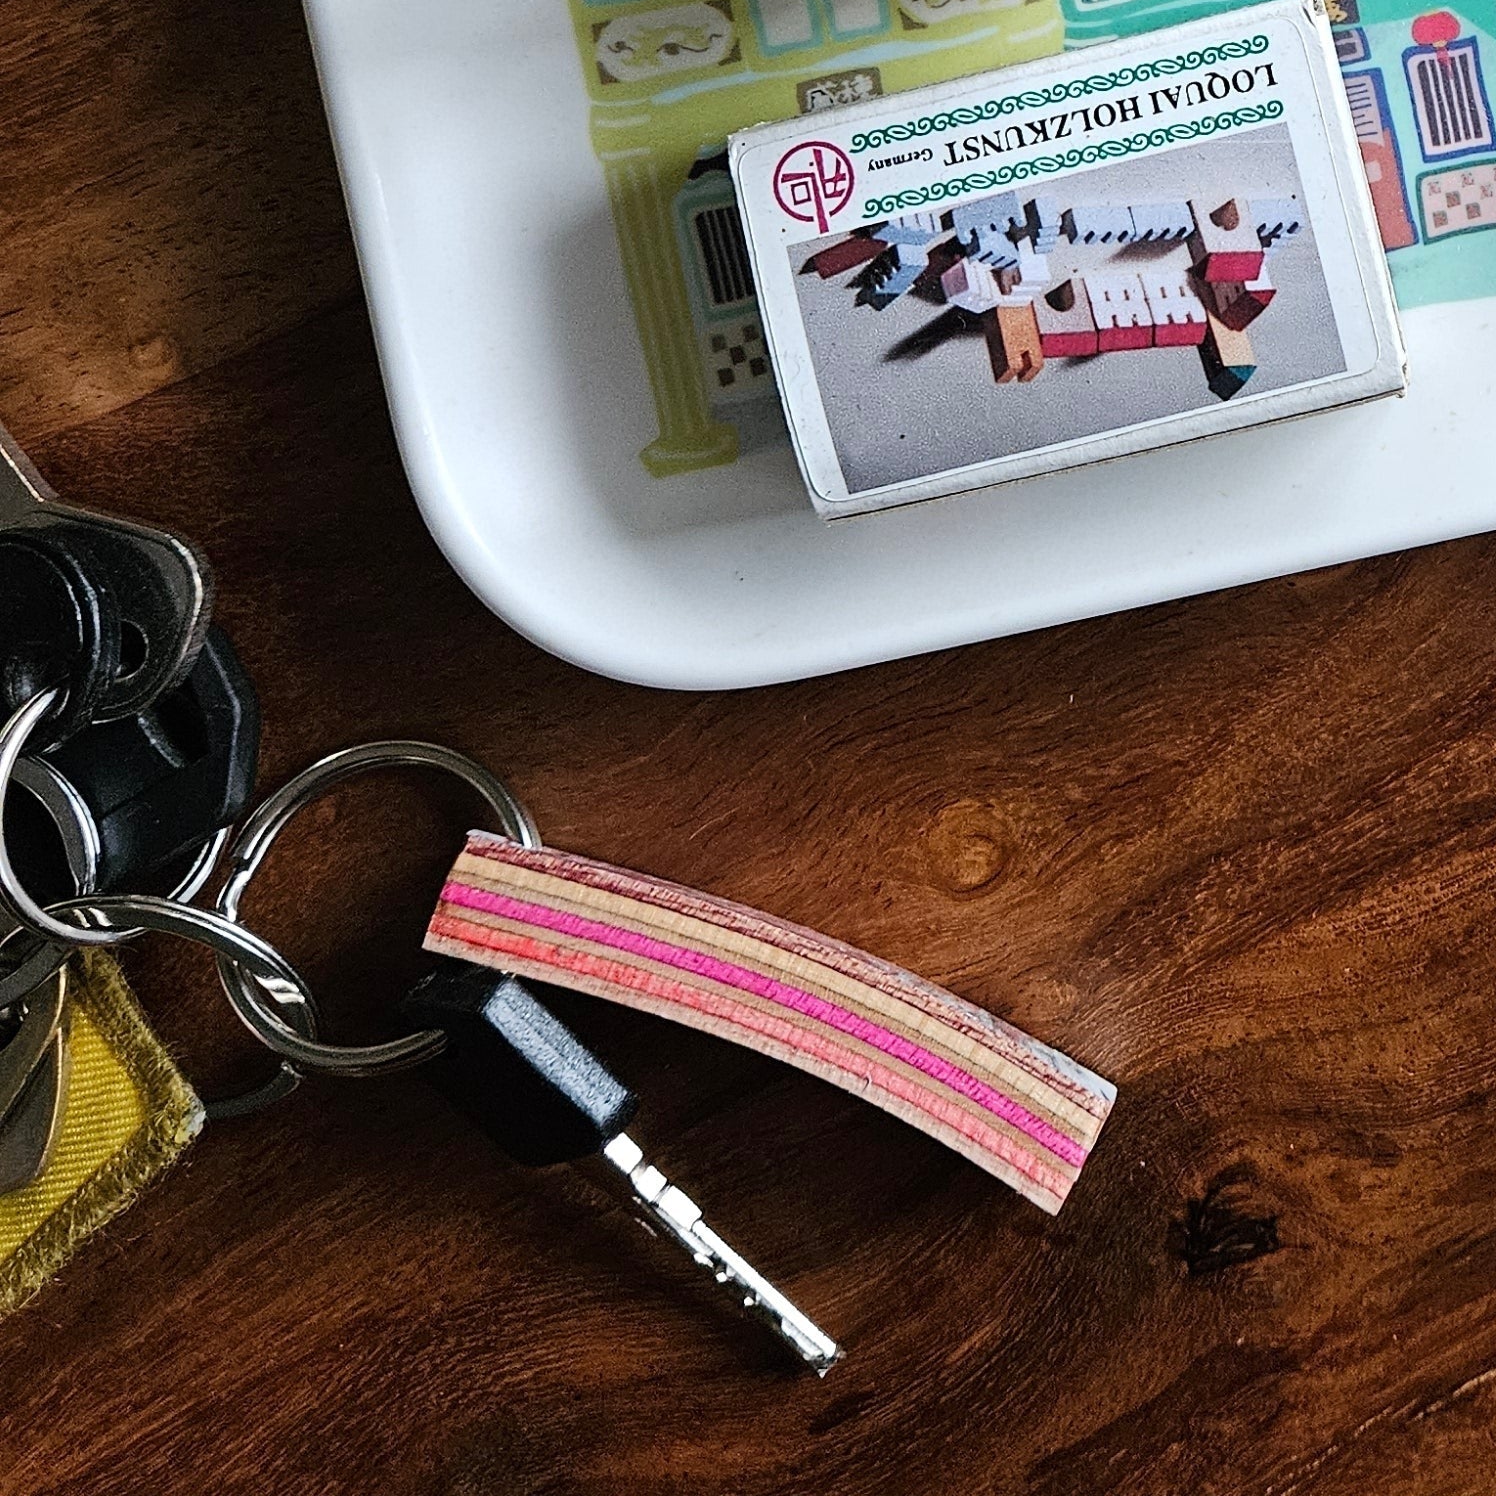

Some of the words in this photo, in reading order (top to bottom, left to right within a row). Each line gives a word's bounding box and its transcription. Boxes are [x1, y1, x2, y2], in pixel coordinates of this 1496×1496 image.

[1148, 62, 1278, 115] LOQUAI
[943, 95, 1143, 167] HOLZKUNST
[867, 148, 933, 172] Germany
